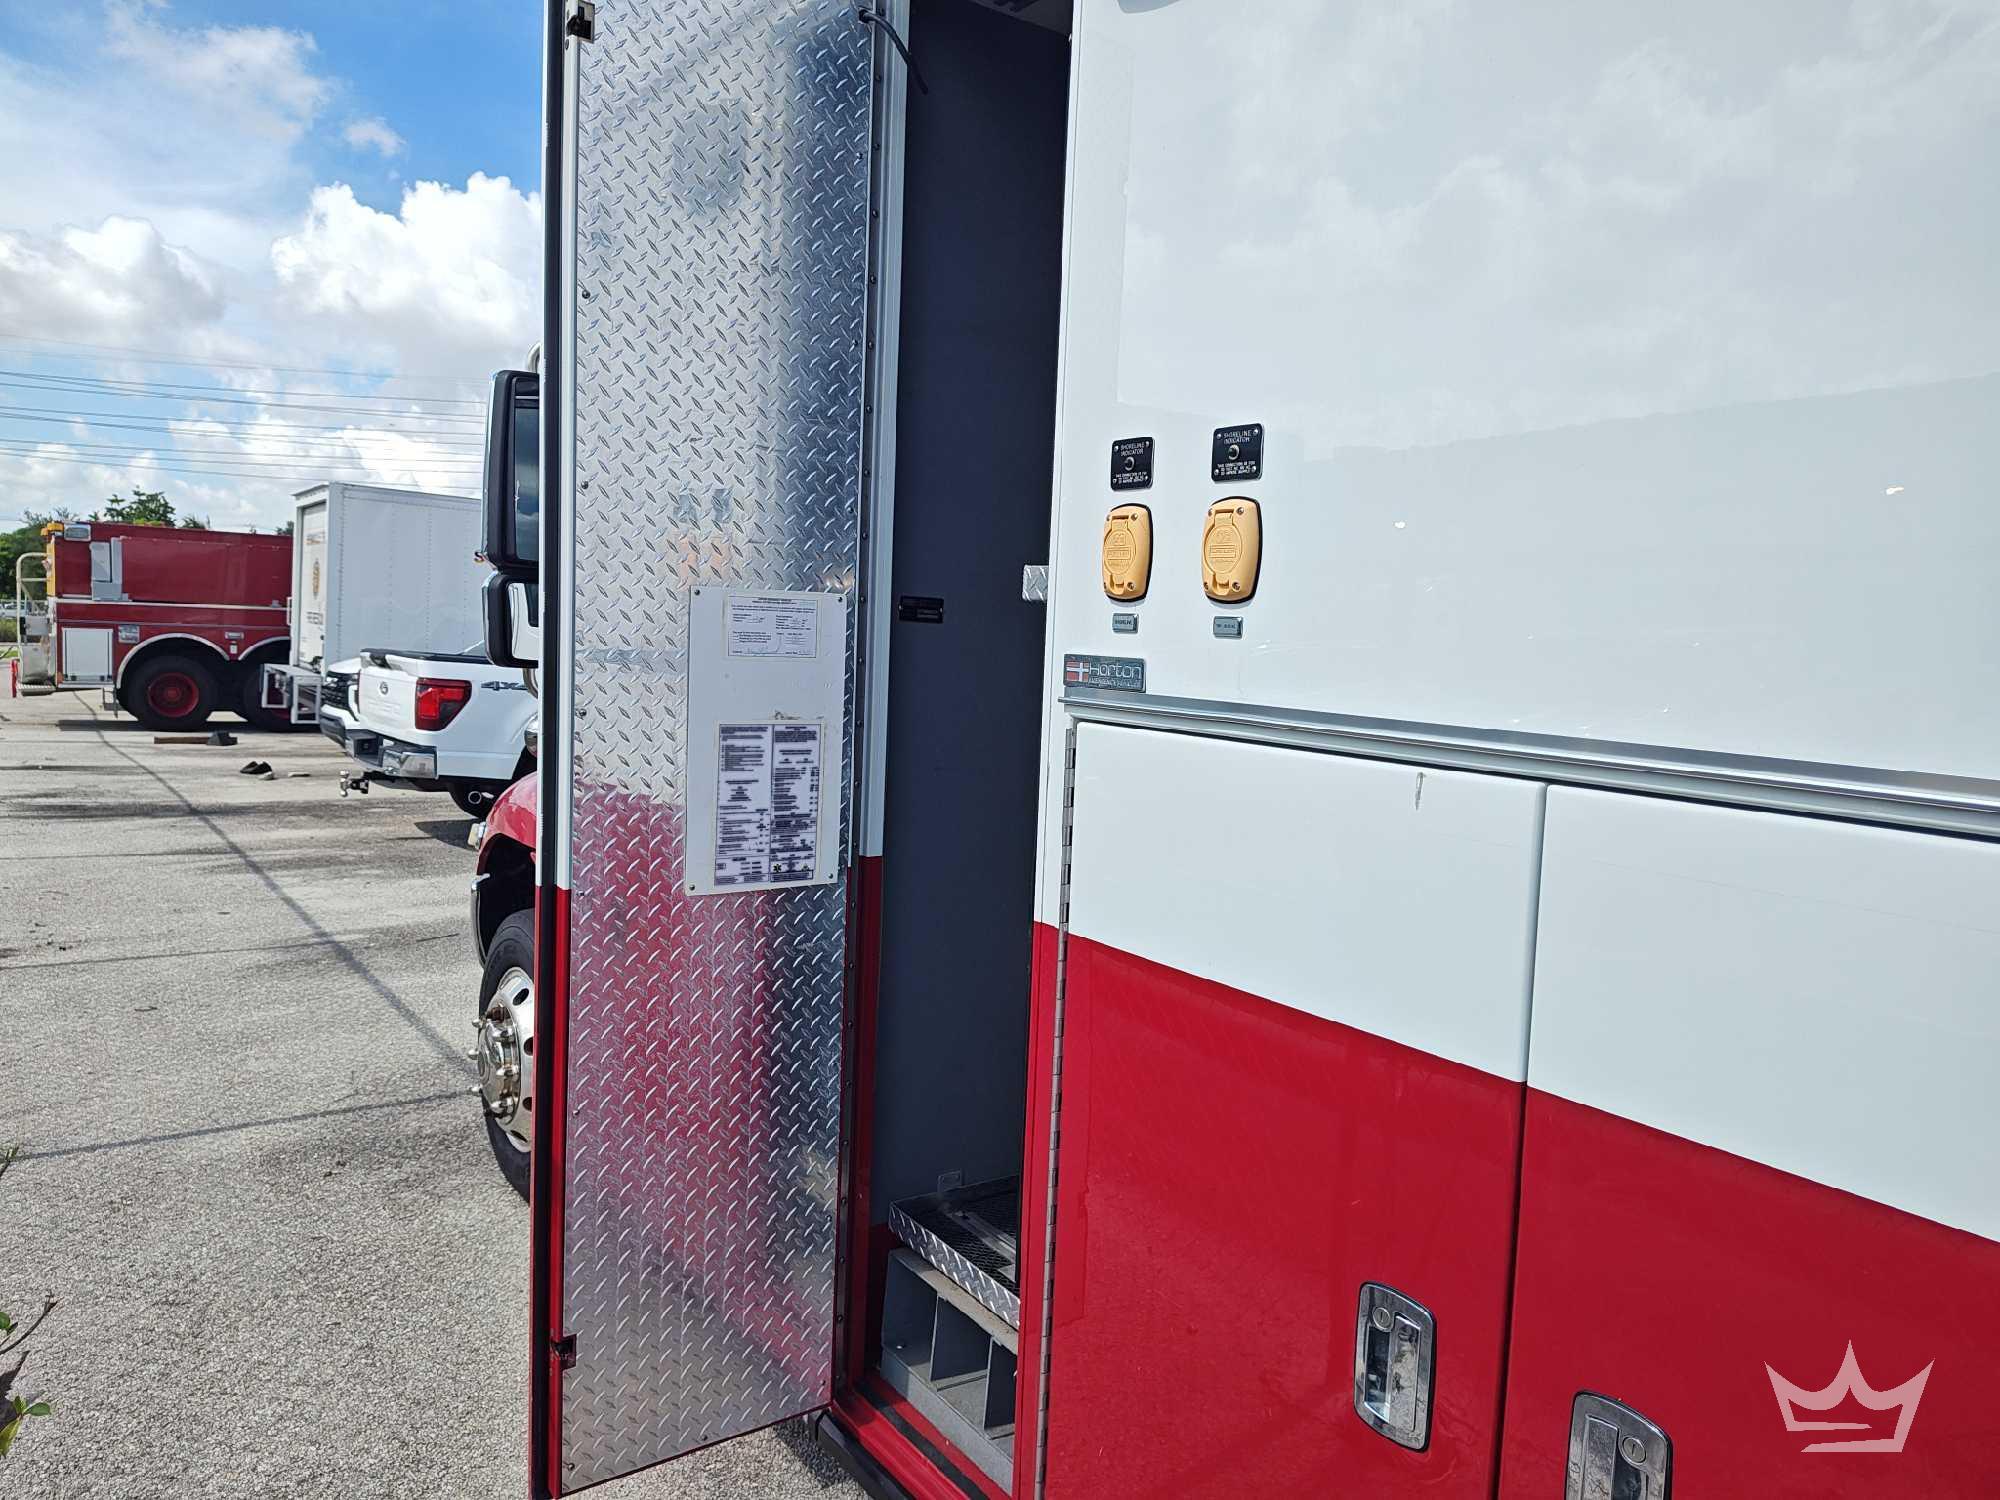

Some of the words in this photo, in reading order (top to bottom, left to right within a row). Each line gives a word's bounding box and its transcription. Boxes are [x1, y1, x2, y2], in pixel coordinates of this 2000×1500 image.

[1223, 430, 1252, 439] SHORELINE
[1223, 437, 1250, 445] INDICATOR
[1120, 442, 1145, 450] SHORELINE
[1120, 448, 1144, 457] INDICATOR
[1088, 662, 1142, 679] Horton
